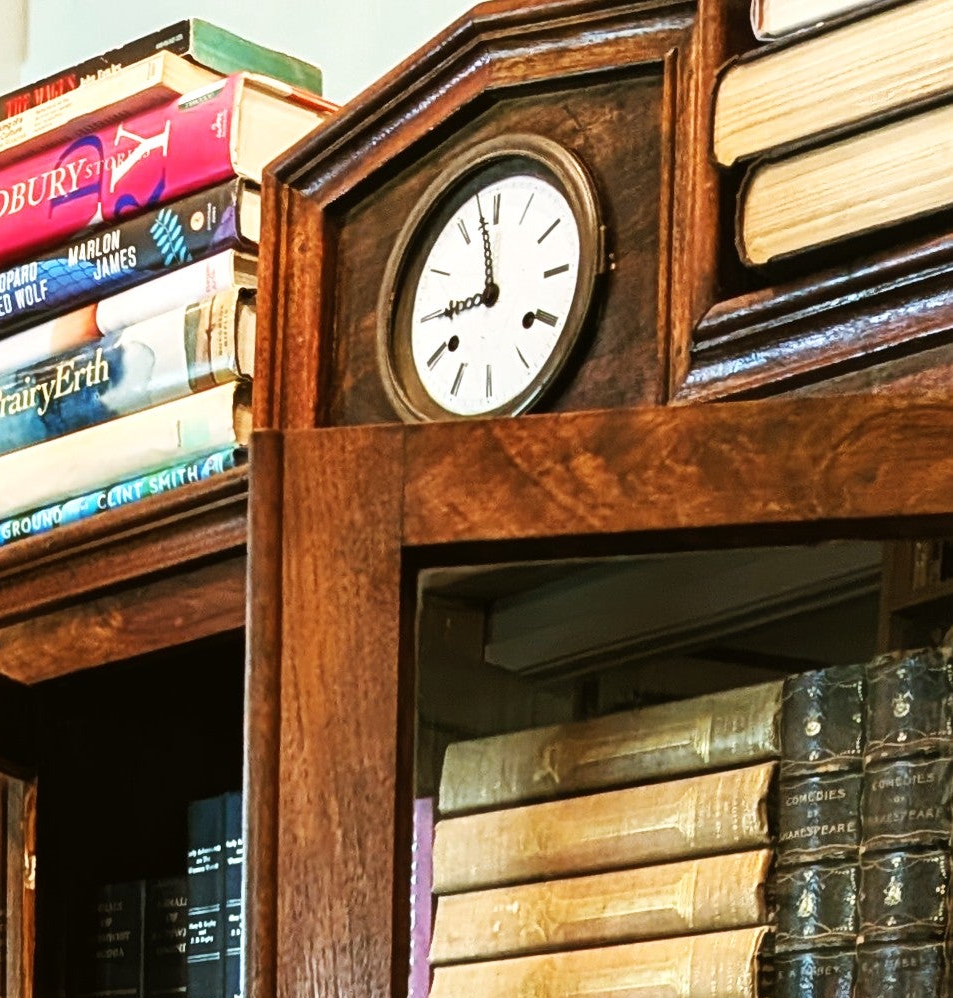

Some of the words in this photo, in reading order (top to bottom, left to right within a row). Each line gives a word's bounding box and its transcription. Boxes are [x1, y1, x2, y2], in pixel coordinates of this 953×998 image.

[67, 229, 121, 268] MARLON
[93, 246, 137, 281] JAMES
[15, 279, 48, 311] WOLF
[96, 482, 145, 510] CLINT
[148, 464, 198, 494] SMITH
[1, 508, 62, 539] GROUND
